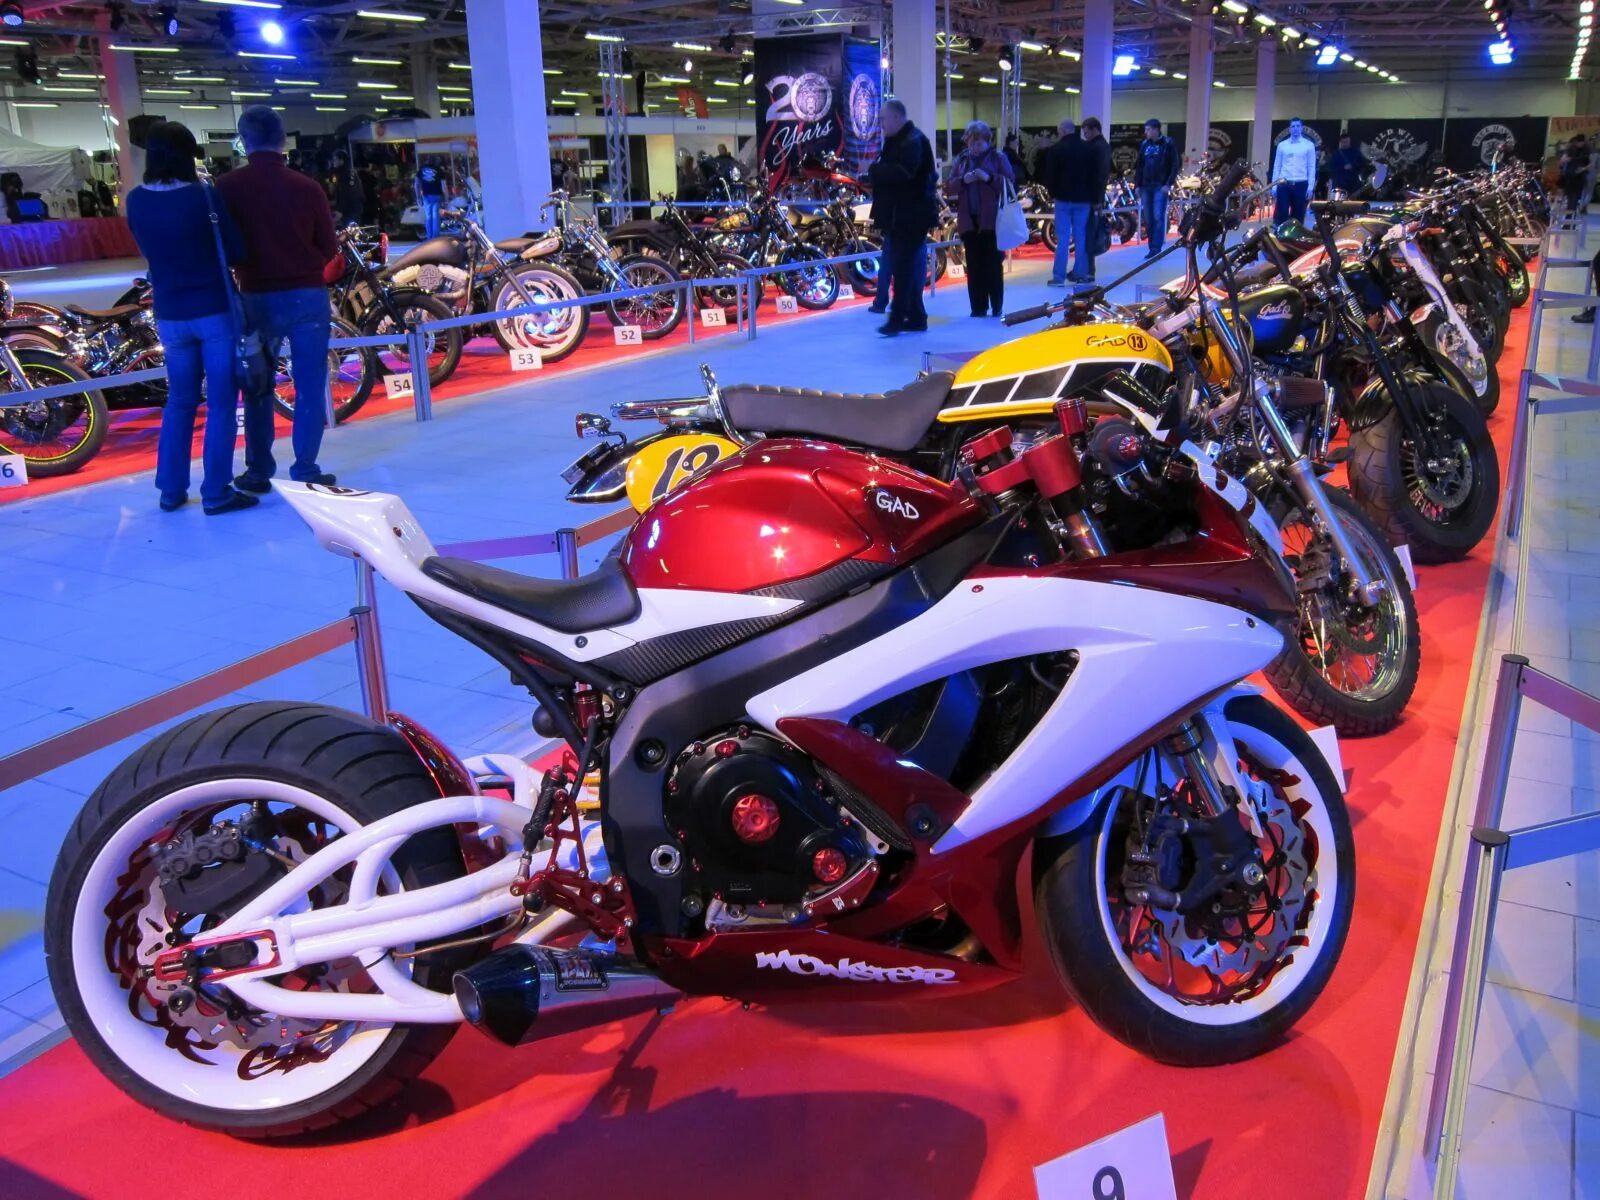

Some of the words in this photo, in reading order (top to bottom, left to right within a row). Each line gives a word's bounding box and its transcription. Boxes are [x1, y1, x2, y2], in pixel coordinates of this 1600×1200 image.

[772, 120, 834, 166] Years
[781, 300, 793, 310] 50
[707, 313, 720, 322] 51
[621, 330, 635, 340] 52
[1130, 335, 1144, 349] 13
[518, 353, 534, 365] 53
[393, 379, 411, 392] 54
[876, 491, 920, 519] GAD
[1092, 1165, 1126, 1200] 9
